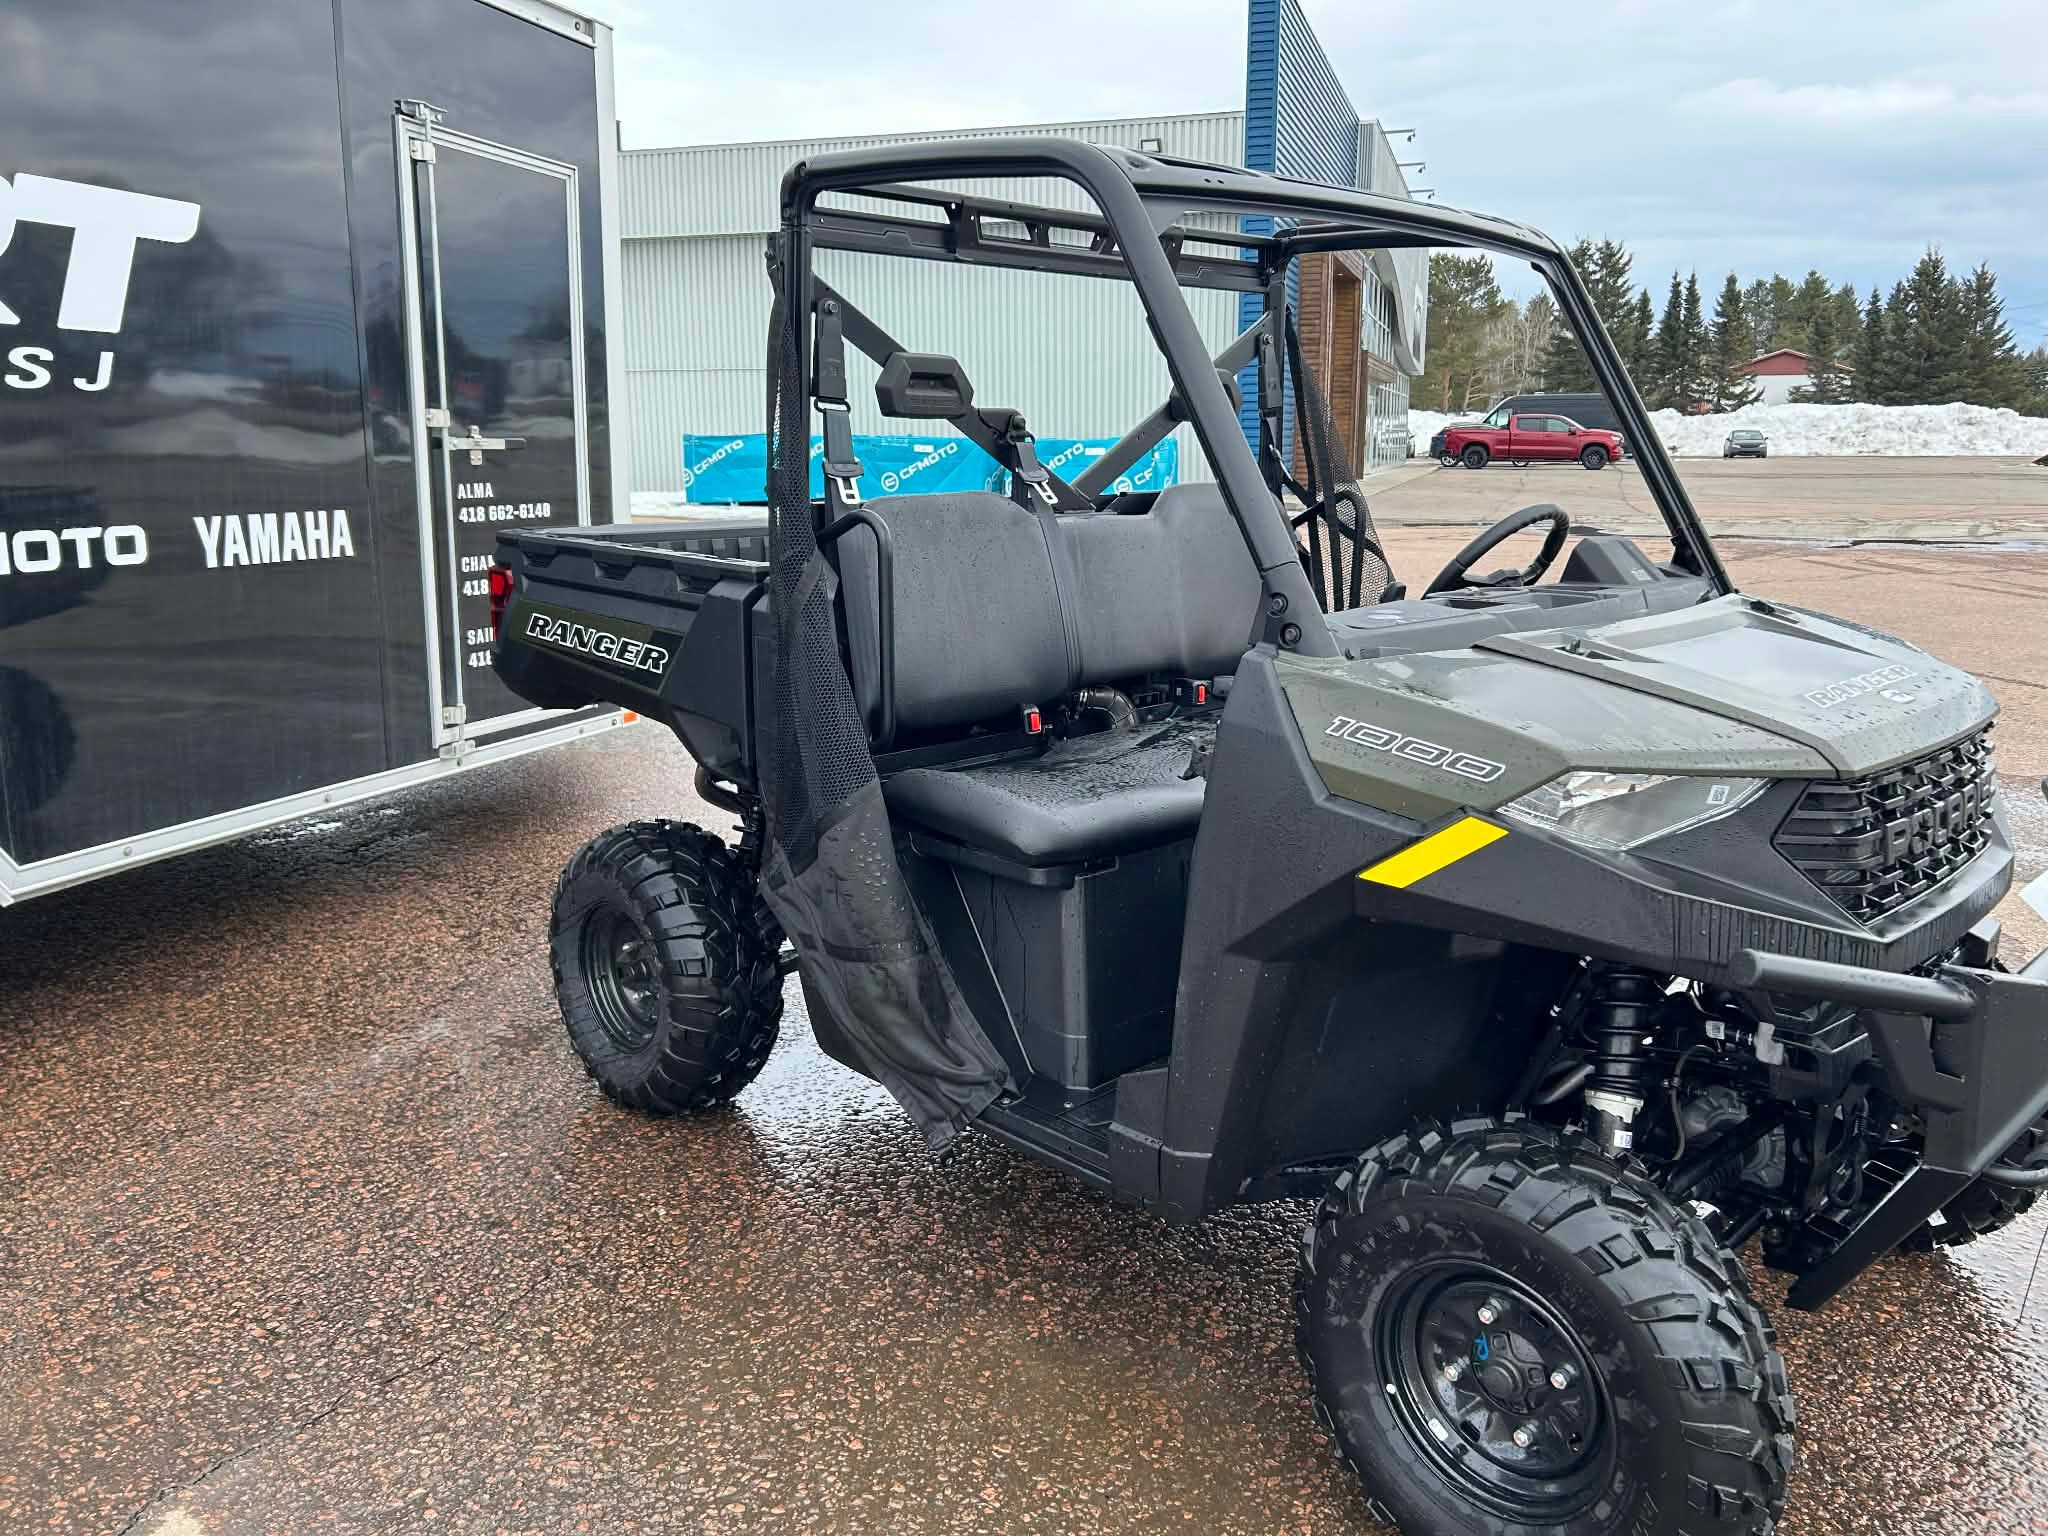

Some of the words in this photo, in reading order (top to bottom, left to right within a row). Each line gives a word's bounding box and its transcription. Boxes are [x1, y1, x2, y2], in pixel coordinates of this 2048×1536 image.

[693, 439, 744, 475] CFMOTO
[899, 442, 958, 480] CFMOTO
[457, 482, 494, 499] ALMA
[459, 506, 485, 523] 418
[0, 524, 148, 575] OTO
[193, 510, 354, 568] YAMAHA
[463, 579, 489, 597] 418
[526, 613, 669, 674] RANGER
[1804, 664, 1919, 709] RANGER
[1325, 715, 1506, 783] 1000
